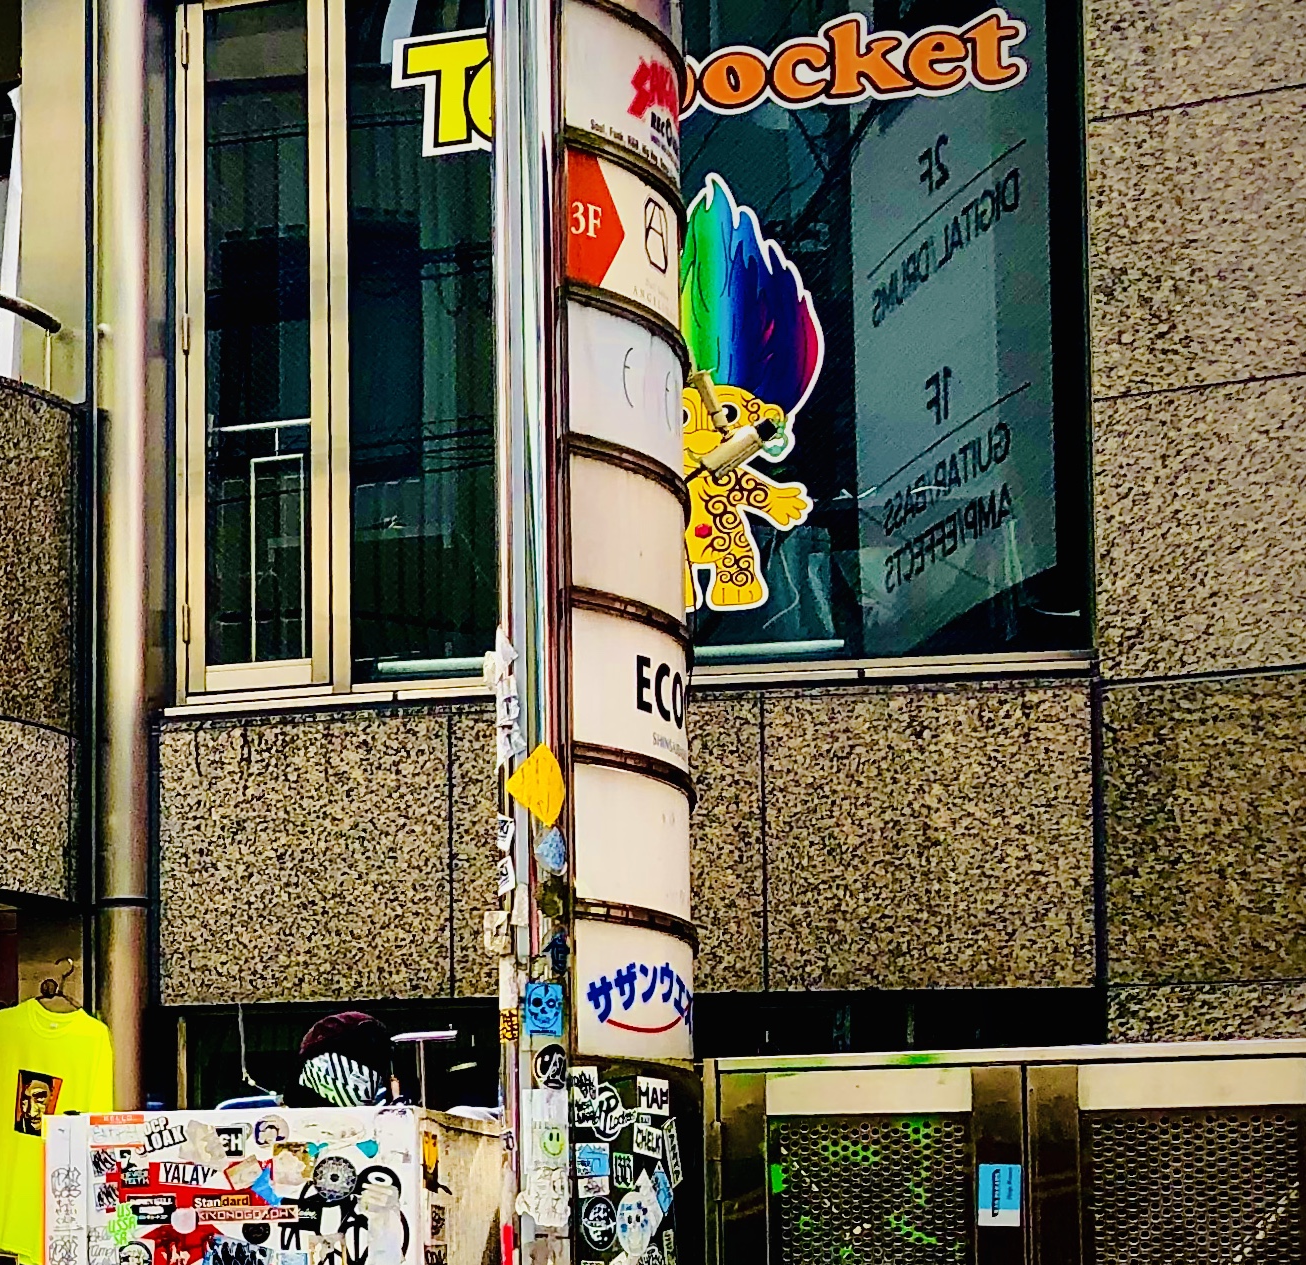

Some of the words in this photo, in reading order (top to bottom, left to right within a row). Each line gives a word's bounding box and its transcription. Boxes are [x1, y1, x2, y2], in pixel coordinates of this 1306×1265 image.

[685, 10, 1024, 110] ocket
[570, 201, 602, 238] 3F
[194, 1196, 249, 1208] Standard
